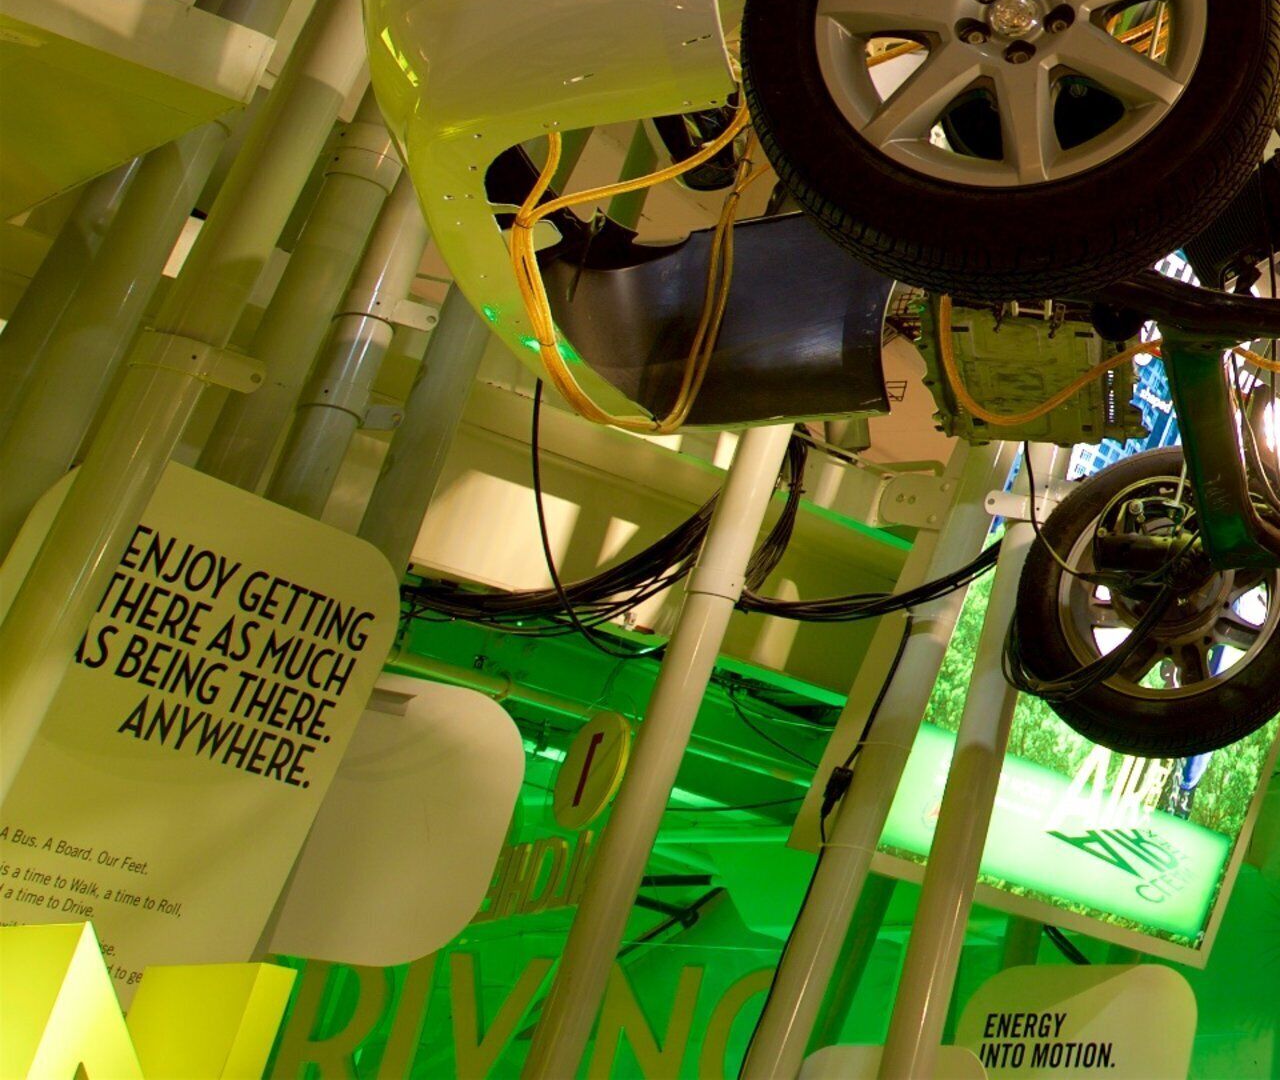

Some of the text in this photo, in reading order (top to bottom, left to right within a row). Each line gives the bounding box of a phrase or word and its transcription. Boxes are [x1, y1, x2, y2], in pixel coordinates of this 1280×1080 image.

[120, 524, 375, 652] ENJOY GETTING
[96, 571, 357, 696] THERE AS MUCH
[114, 634, 229, 705] BEING
[229, 671, 337, 744] THERE.
[117, 694, 316, 789] ANYWHERE.
[11, 829, 38, 848] Bus.
[42, 837, 53, 852] A
[55, 839, 93, 862] Board.
[97, 850, 120, 867] Our
[121, 856, 148, 875] Feet.
[4, 887, 95, 918] a time to Drive.
[11, 866, 21, 878] a
[23, 868, 51, 886] time
[55, 875, 68, 890] to
[70, 877, 100, 898] Walk,
[103, 889, 113, 901] a
[114, 889, 142, 907] time
[143, 896, 156, 911] to
[157, 899, 183, 918] Roll,
[114, 966, 128, 980] to
[982, 1012, 1067, 1038] ENERGY
[979, 1042, 1116, 1068] INTO MOTION.
